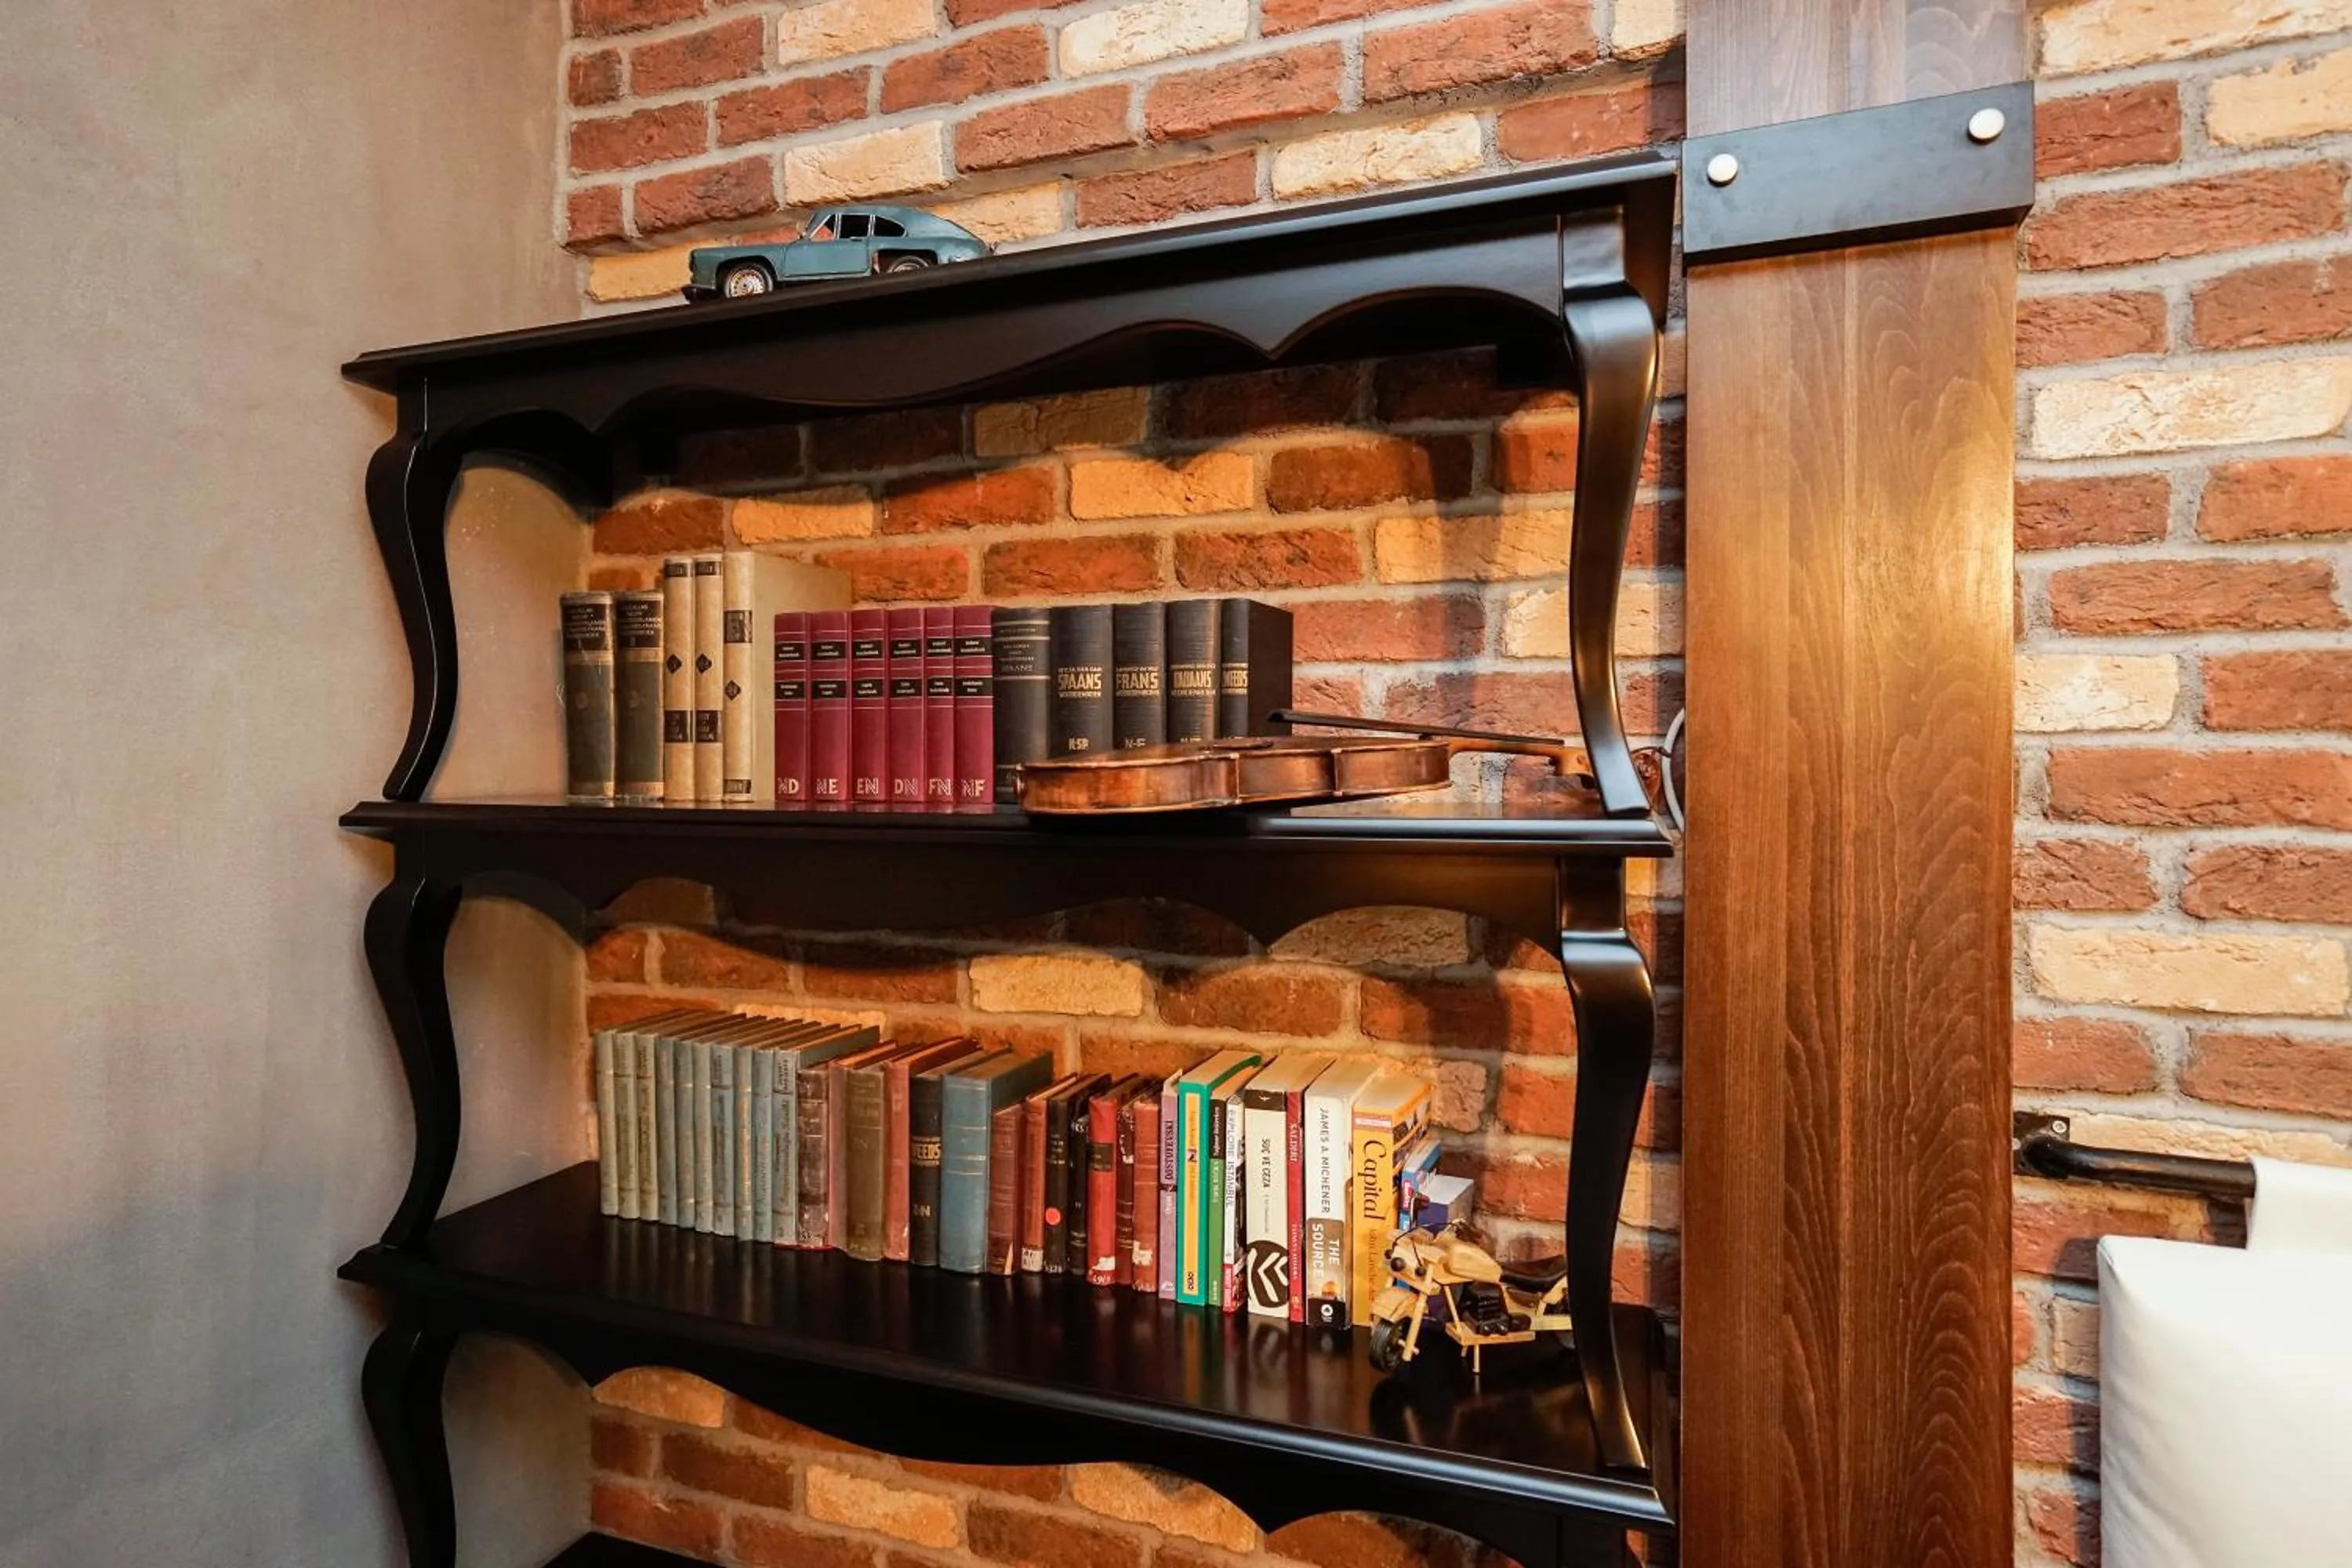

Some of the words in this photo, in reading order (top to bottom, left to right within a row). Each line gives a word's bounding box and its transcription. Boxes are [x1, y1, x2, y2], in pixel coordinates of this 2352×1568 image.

[1058, 673, 1102, 690] SPAANS
[1116, 672, 1159, 690] FRANS
[777, 778, 800, 794] ND
[816, 778, 839, 794] NE
[857, 778, 879, 794] EN
[895, 779, 918, 797] DN
[928, 779, 953, 797] FN
[960, 778, 985, 797] NF
[1319, 1107, 1329, 1143] JAMES
[1262, 1156, 1271, 1166] VE
[1226, 1161, 1236, 1208] ISTANBUL
[1261, 1168, 1271, 1188] CEZA
[1321, 1156, 1330, 1214] MICHENER
[1357, 1140, 1386, 1221] Capital
[1312, 1223, 1324, 1279] SOURCE
[1329, 1238, 1340, 1265] THE
